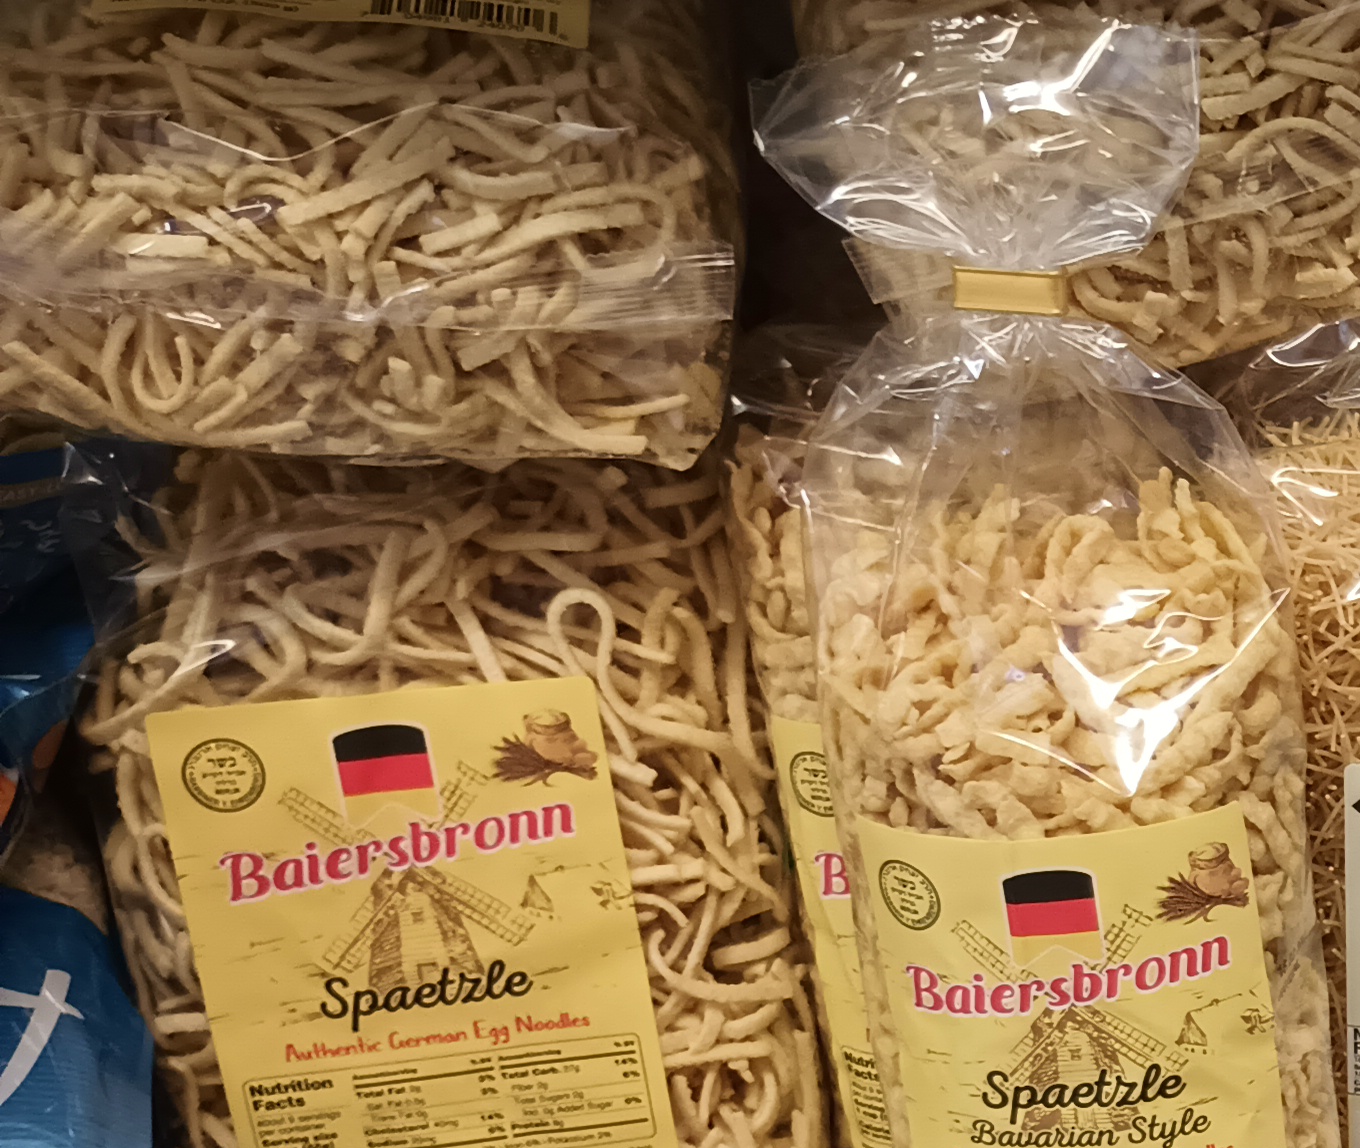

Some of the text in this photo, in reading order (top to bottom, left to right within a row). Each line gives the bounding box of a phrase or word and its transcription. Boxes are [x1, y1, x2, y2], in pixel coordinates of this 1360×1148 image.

[220, 802, 574, 901] Baiersbronn
[321, 958, 534, 1032] Spaetzle
[906, 935, 1230, 1017] Baiersbronn
[285, 1013, 590, 1063] Authentic German Egg Noodles
[249, 1078, 333, 1098] Nutrition
[253, 1096, 306, 1111] Facts
[981, 1063, 1187, 1124] Spaetzle
[970, 1108, 1211, 1148] Bavarian Style
